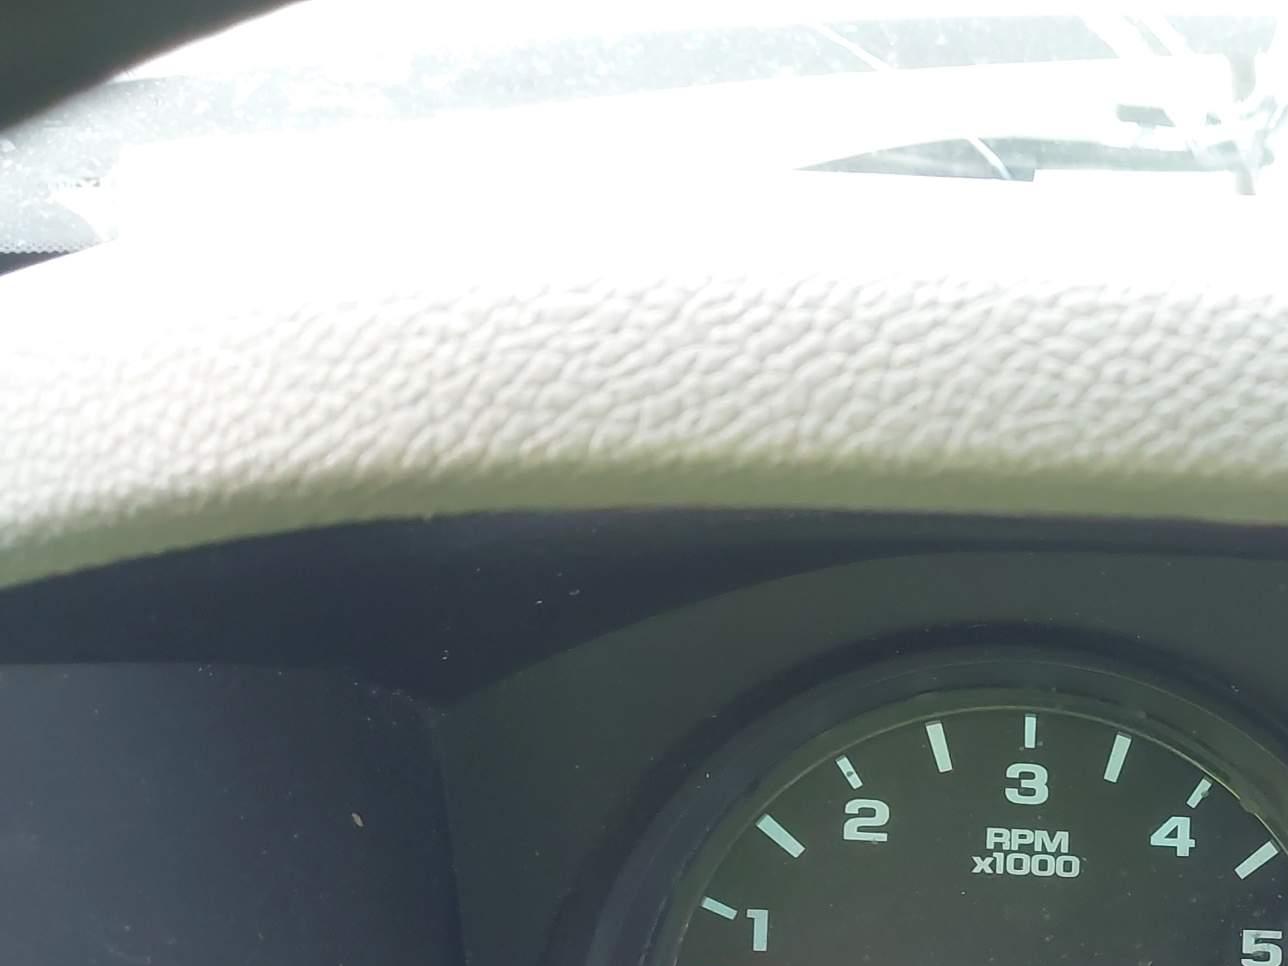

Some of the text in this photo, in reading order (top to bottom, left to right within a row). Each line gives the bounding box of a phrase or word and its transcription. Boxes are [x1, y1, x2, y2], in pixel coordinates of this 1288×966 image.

[1005, 763, 1048, 805] 3
[843, 799, 890, 842] 2
[985, 829, 1069, 853] RPM
[1150, 816, 1195, 856] 4
[972, 853, 1080, 879] x1000
[746, 909, 768, 951] 1
